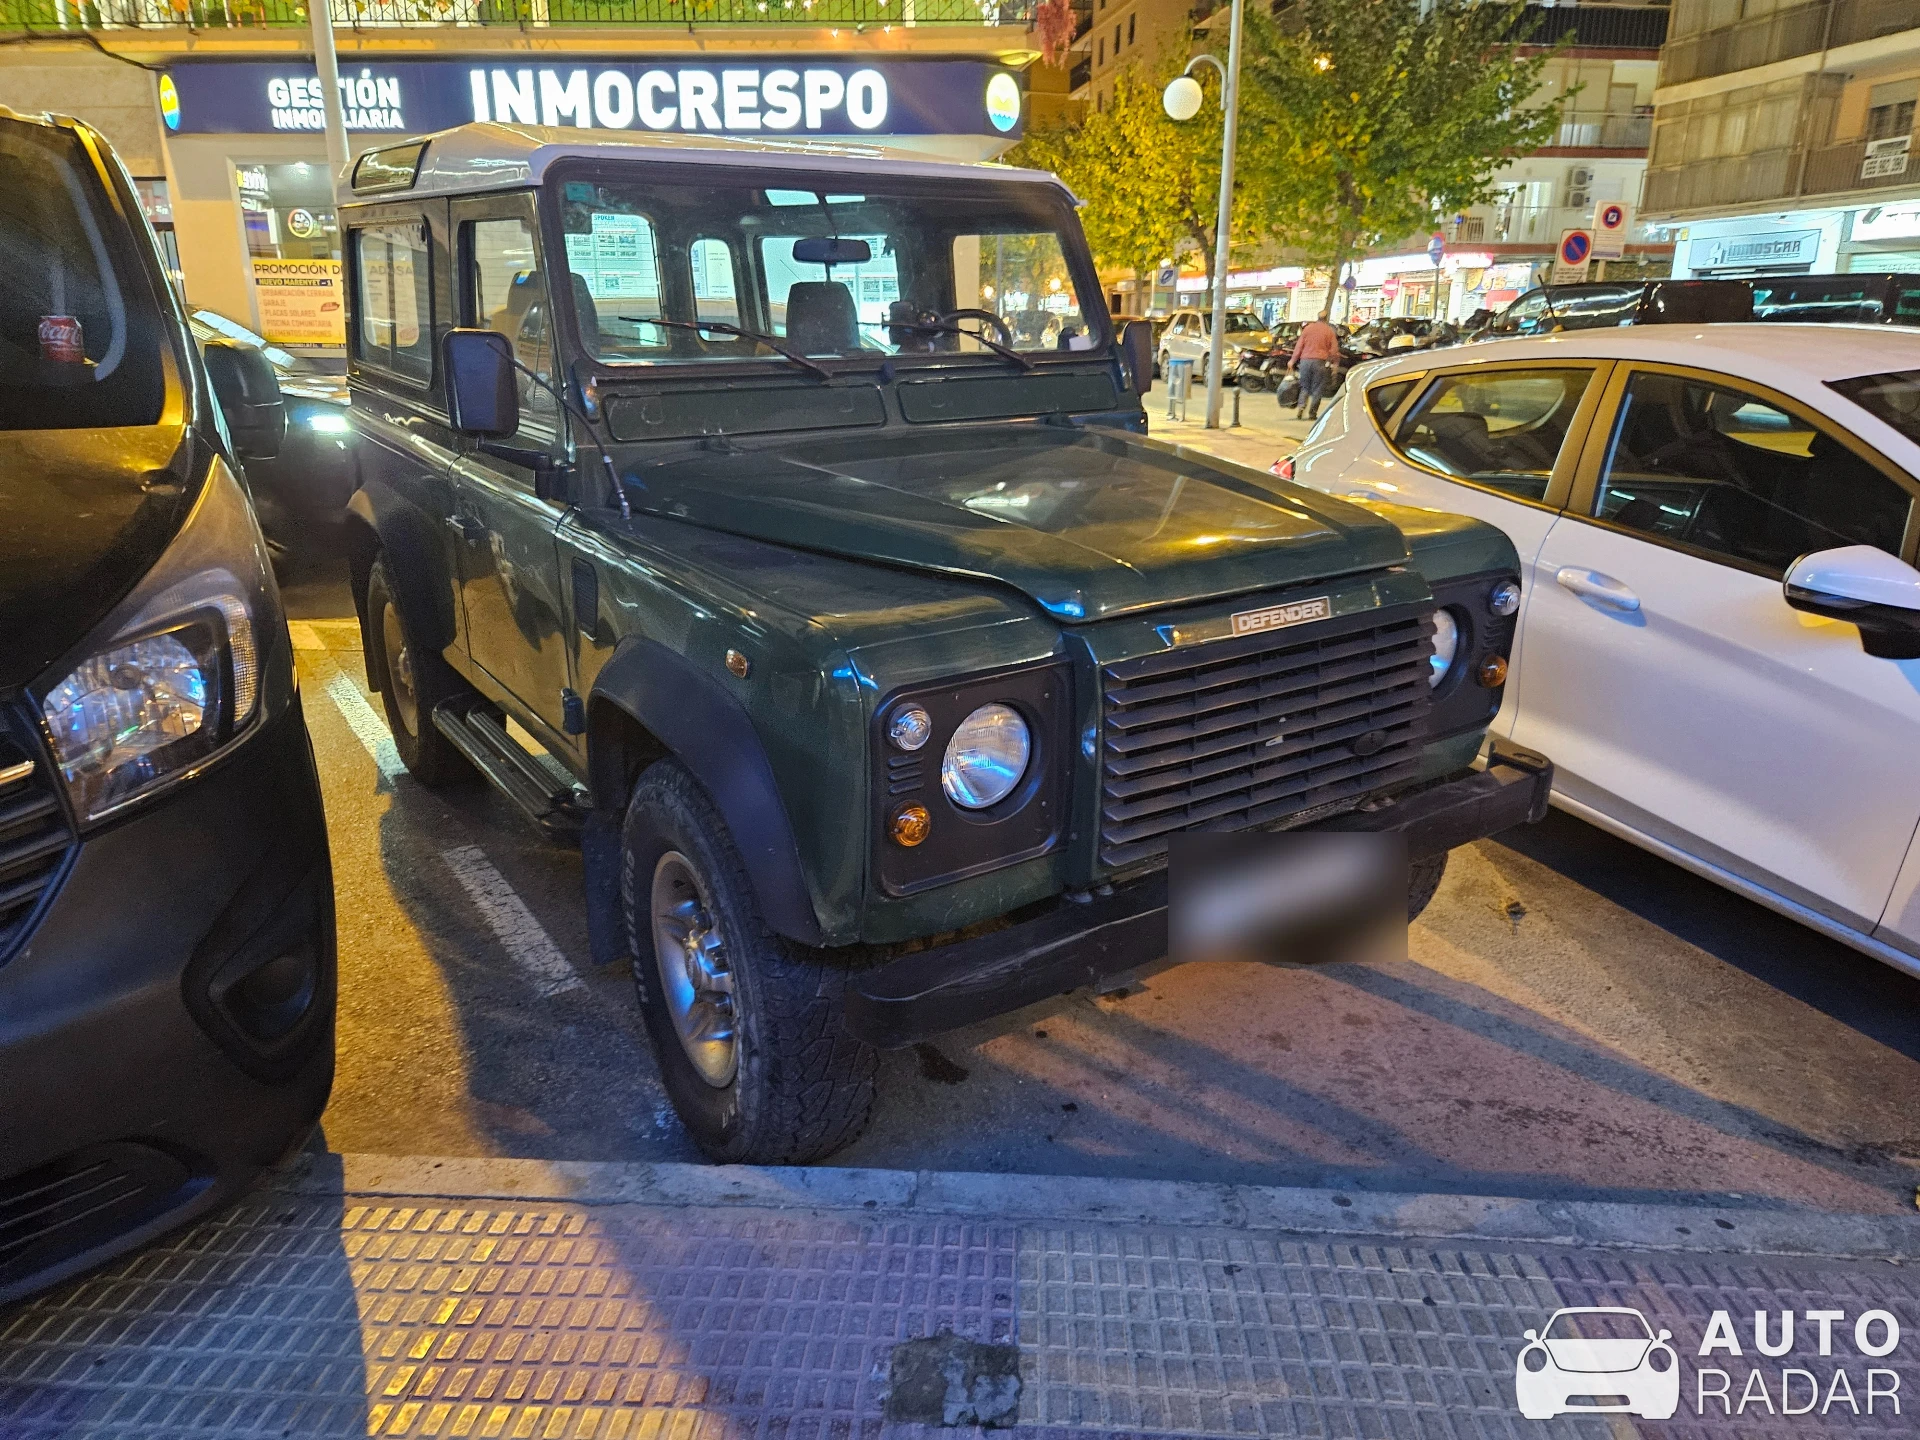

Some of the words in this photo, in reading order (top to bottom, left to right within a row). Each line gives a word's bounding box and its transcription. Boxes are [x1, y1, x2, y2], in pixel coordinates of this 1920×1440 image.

[470, 69, 888, 129] INMOCRESPO
[271, 108, 405, 129] INMOLIARIA
[253, 261, 328, 275] PROMOCIÓN
[1238, 601, 1325, 632] DEFENDER
